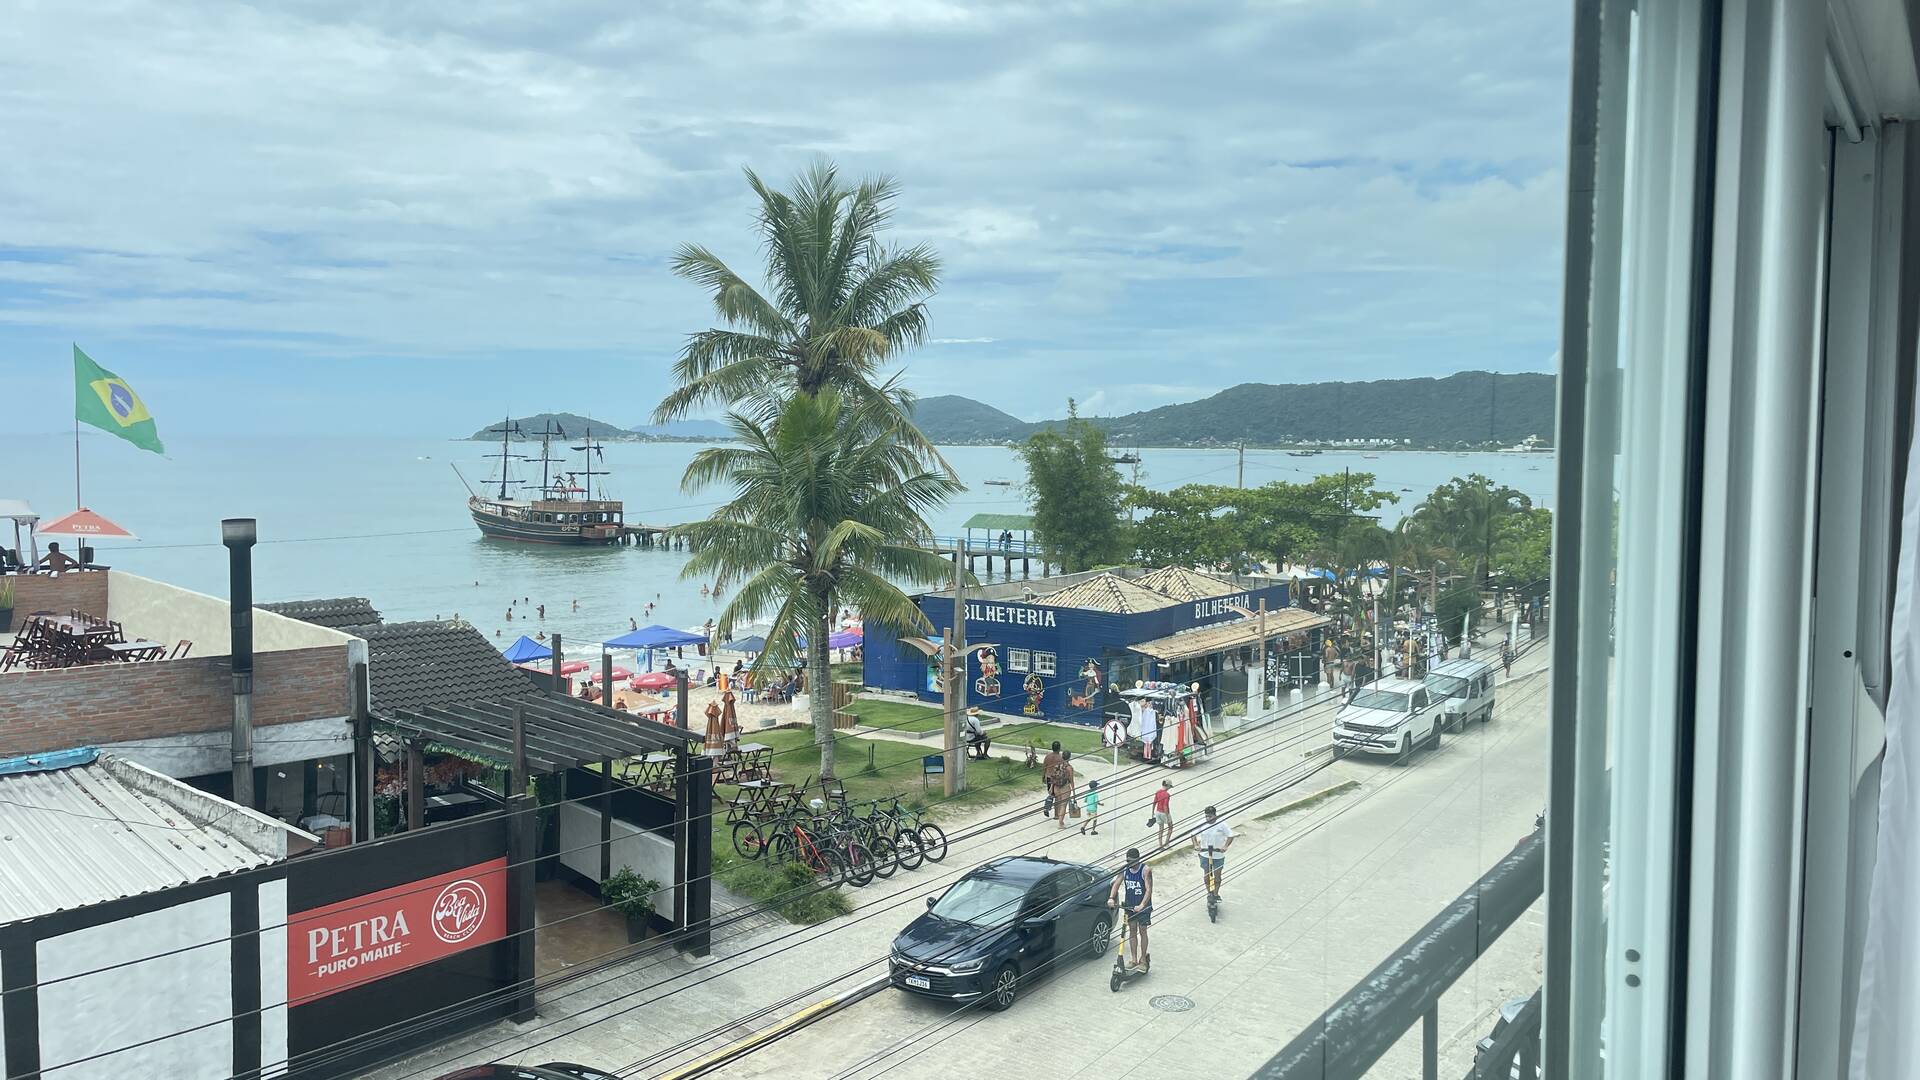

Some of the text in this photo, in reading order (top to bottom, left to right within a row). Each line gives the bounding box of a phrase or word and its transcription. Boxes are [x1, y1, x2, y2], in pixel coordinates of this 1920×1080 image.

[1195, 594, 1250, 619] BILHETERIA
[318, 942, 402, 978] PURO MALTE
